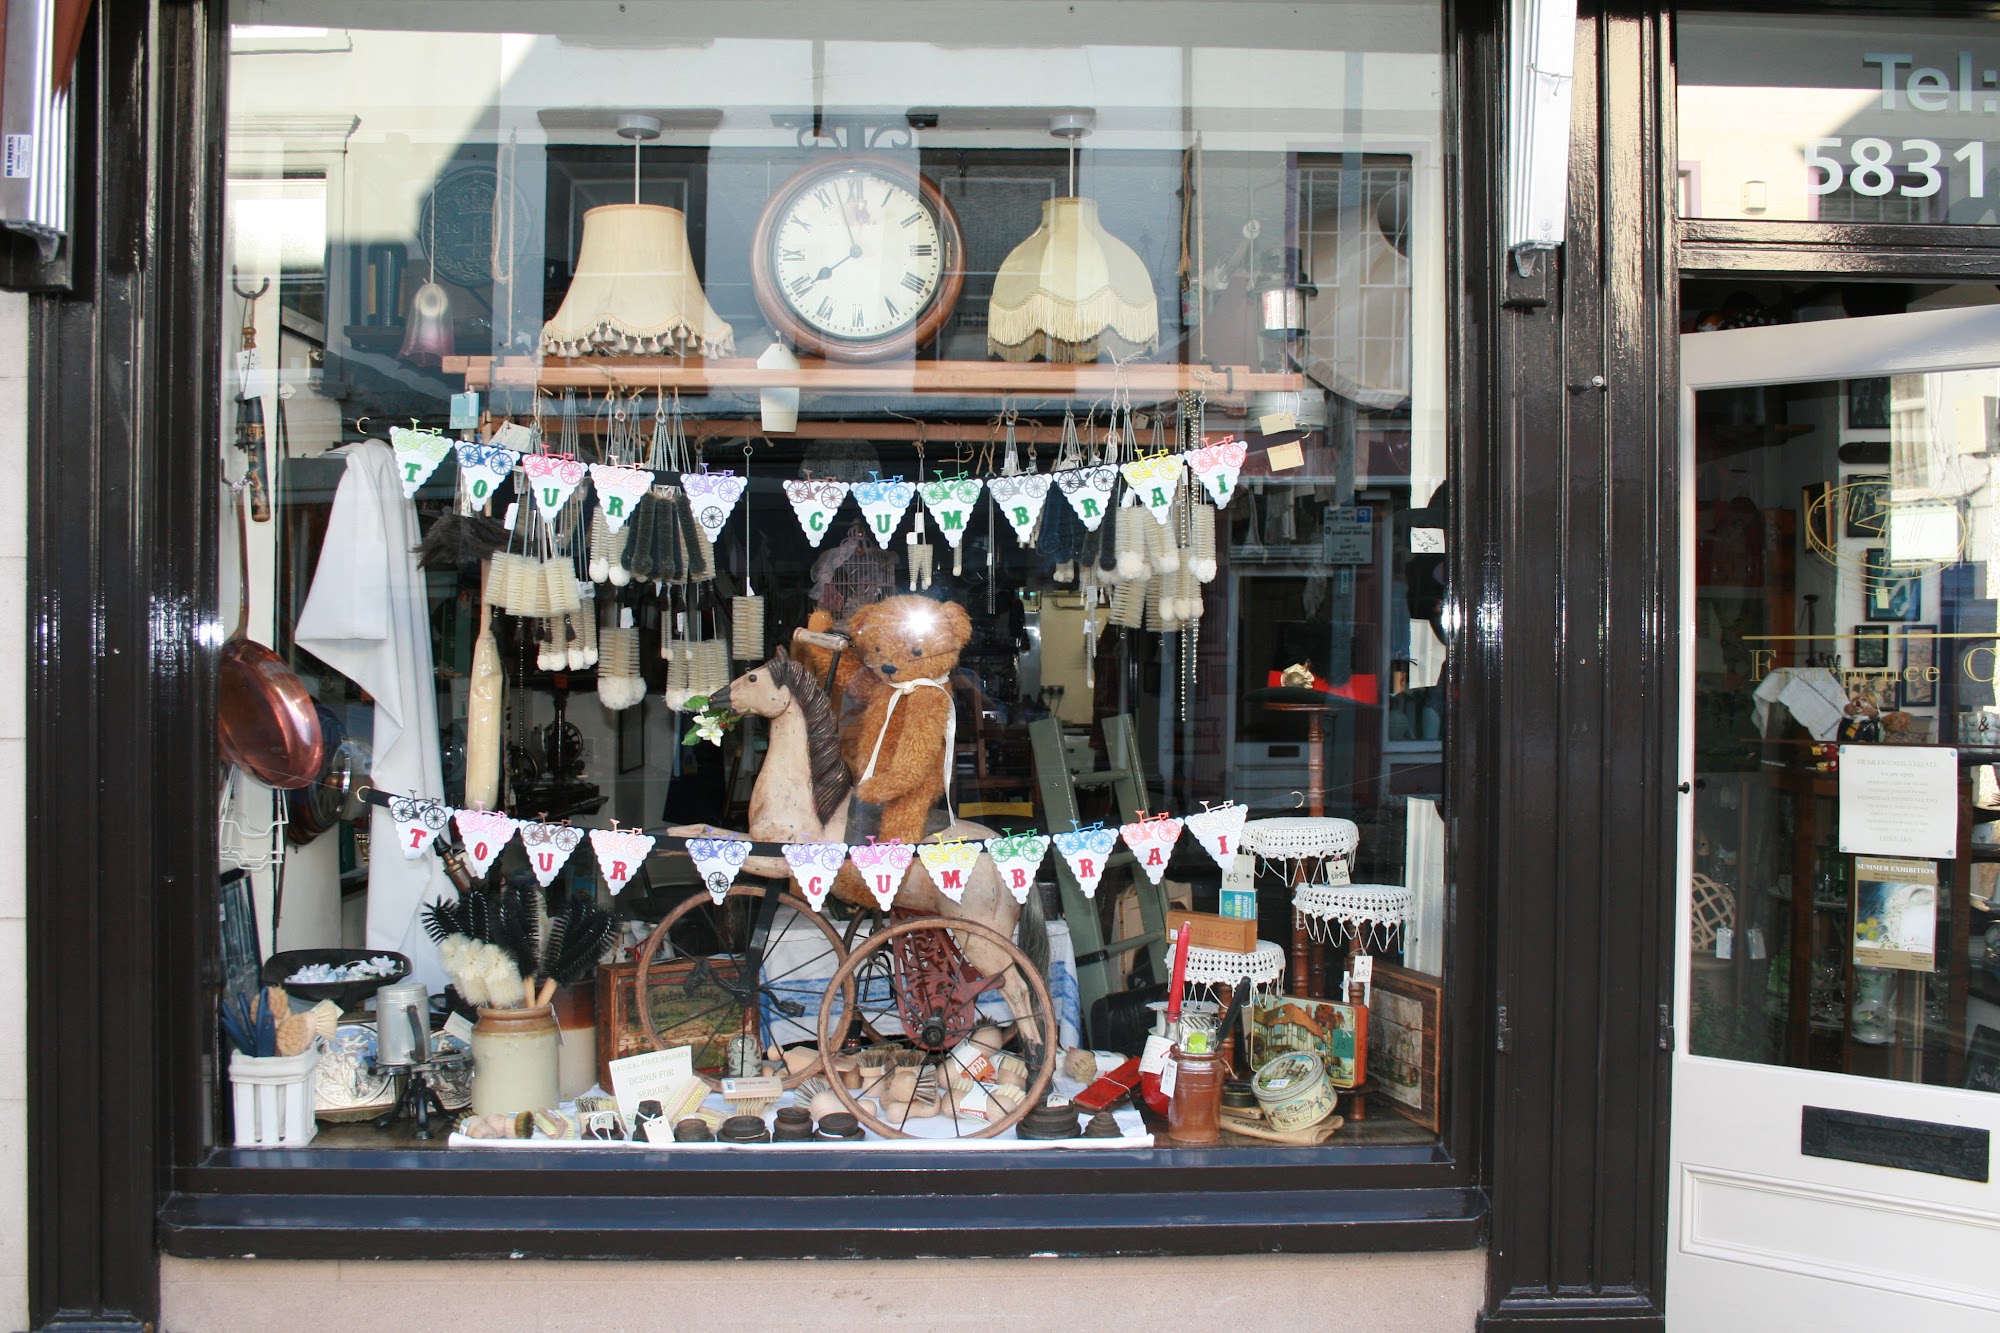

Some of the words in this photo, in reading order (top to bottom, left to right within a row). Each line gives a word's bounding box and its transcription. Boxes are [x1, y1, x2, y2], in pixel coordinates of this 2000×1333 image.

[1863, 50, 1997, 113] Tel:
[1748, 649, 1942, 689] Fourpence
[1856, 863, 1889, 872] SUMMER
[1890, 866, 1935, 875] EXHIBITION
[628, 1071, 658, 1086] DESIGN
[659, 1068, 675, 1078] FOR
[637, 1084, 670, 1099] SERIOUS
